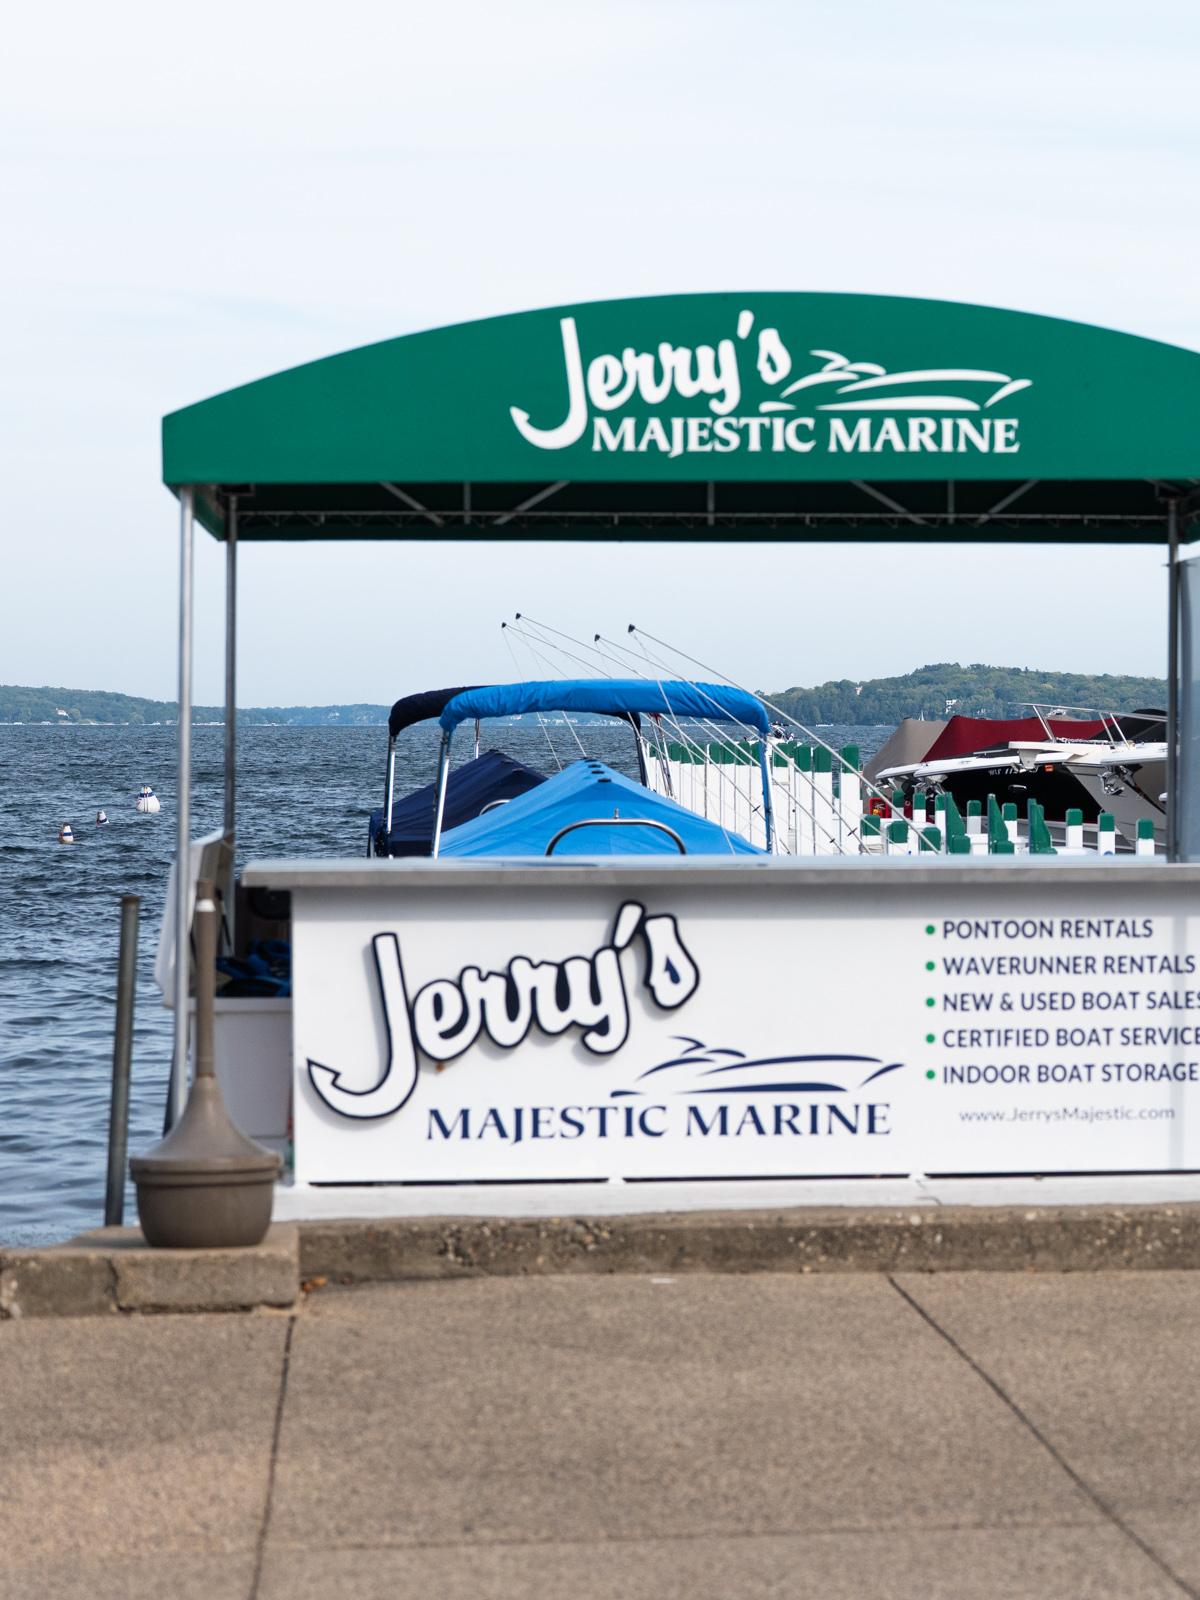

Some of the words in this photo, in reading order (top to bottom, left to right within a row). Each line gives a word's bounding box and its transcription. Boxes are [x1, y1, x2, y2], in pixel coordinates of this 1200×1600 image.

[509, 309, 792, 450] Jerry's
[592, 415, 816, 458] MAJESTIC
[828, 417, 1020, 453] MARINE
[943, 919, 1054, 940] PONTOON
[1060, 918, 1153, 939] RENTALS
[942, 955, 1097, 976] WAVERUNNER
[1103, 954, 1196, 975] RENTALS
[305, 899, 700, 1120] Jerry's
[943, 992, 994, 1012] NEW
[999, 992, 1013, 1011] &
[1020, 991, 1076, 1011] USED
[1082, 991, 1140, 1011] BOAT
[942, 1028, 1050, 1048] CERTIFIED
[1056, 1027, 1114, 1047] BOAT
[943, 1064, 1030, 1084] INDOOR
[1037, 1063, 1095, 1083] BOAT
[1101, 1061, 1199, 1083] STORAGE
[427, 1105, 667, 1144] MAJESTIC
[686, 1103, 890, 1137] MARINE
[958, 1106, 1176, 1124] www.JerrysMajestic.com
